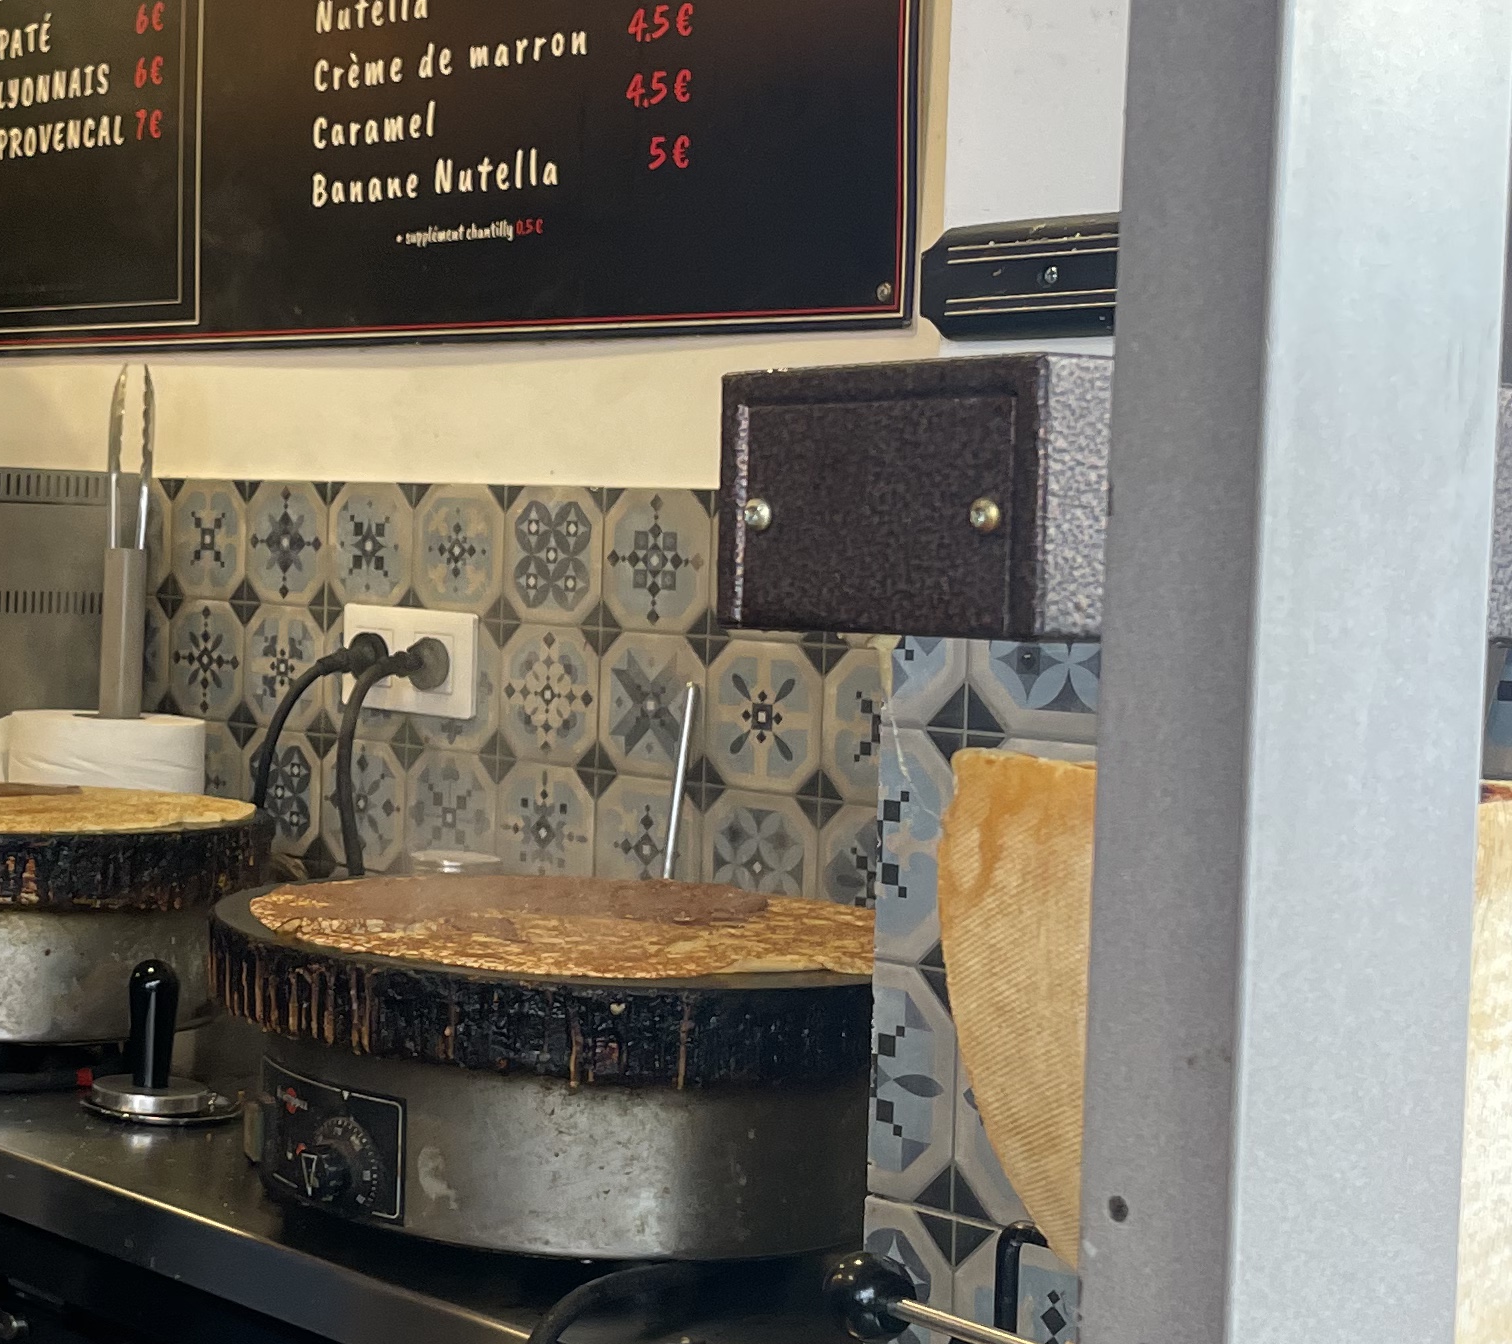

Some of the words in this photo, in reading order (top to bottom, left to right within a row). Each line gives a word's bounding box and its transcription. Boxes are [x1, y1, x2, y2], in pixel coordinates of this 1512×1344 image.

[314, 53, 403, 93] Crème
[418, 43, 453, 80] de
[469, 28, 588, 70] marron
[313, 101, 436, 150] Caramel
[312, 169, 419, 209] Banane
[434, 148, 559, 197] Nutella
